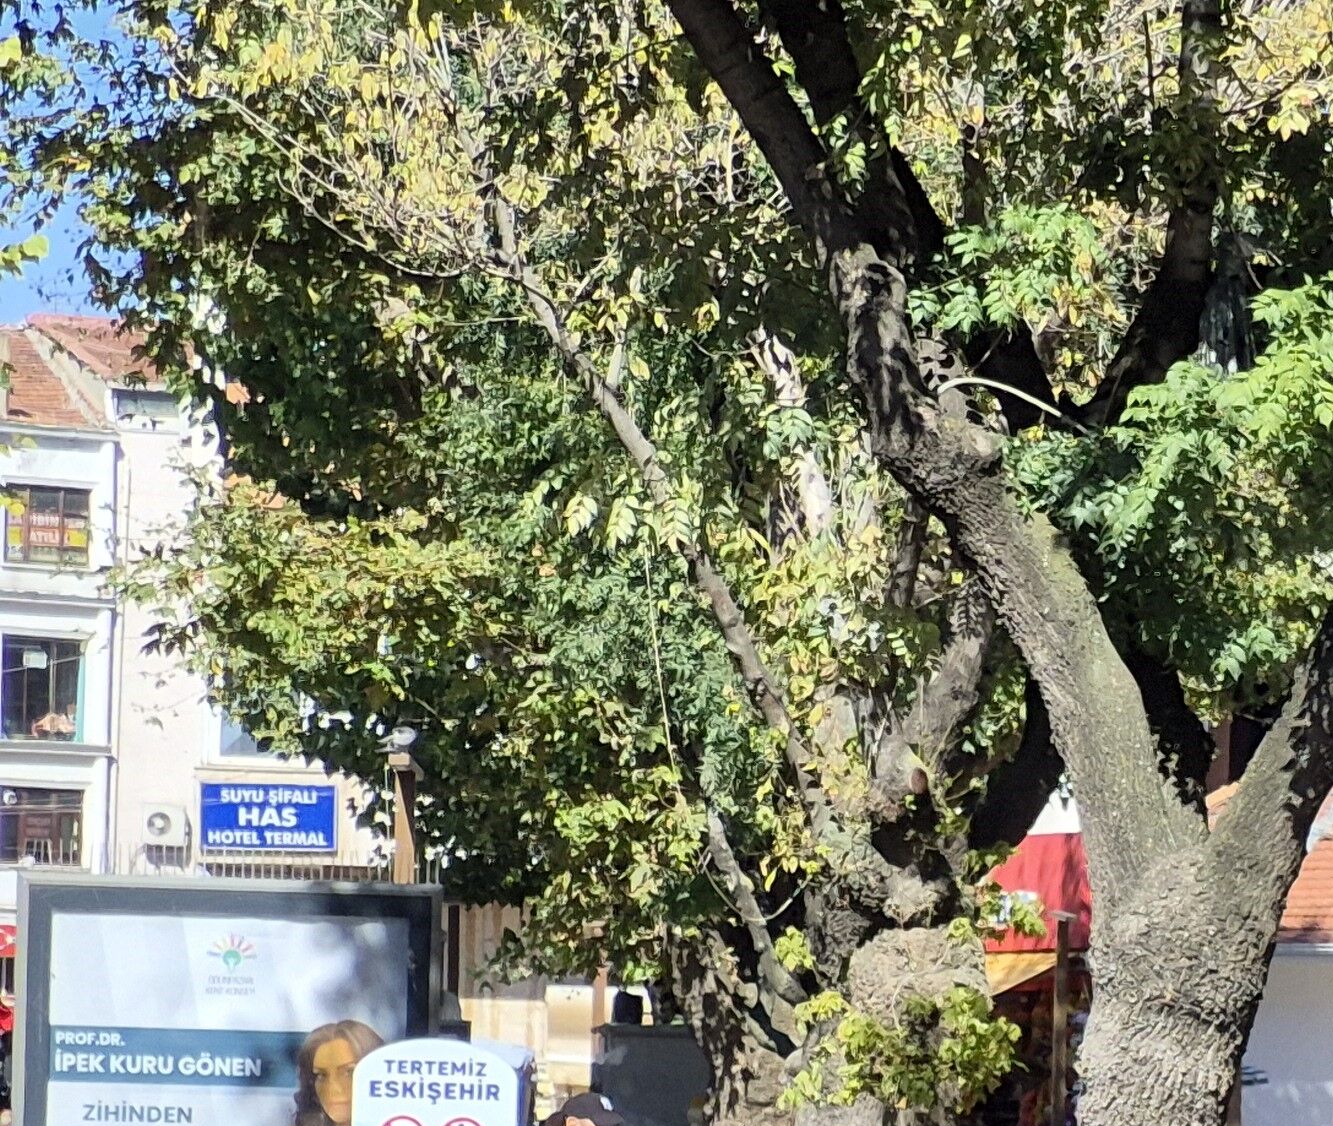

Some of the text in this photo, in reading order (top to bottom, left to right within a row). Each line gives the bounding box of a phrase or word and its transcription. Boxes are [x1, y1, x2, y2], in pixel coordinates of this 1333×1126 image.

[220, 787, 317, 806] SUYU ŞİFALI
[238, 806, 298, 827] HAS
[207, 830, 328, 846] HOTEL TERMAL
[55, 1031, 126, 1047] PROF.DR.
[54, 1048, 262, 1078] İPEK KURU GÖNEN
[384, 1058, 487, 1077] TERTEMİZ
[369, 1076, 500, 1105] ESKİŞEHİR
[82, 1099, 193, 1124] ZİHİNDEN
